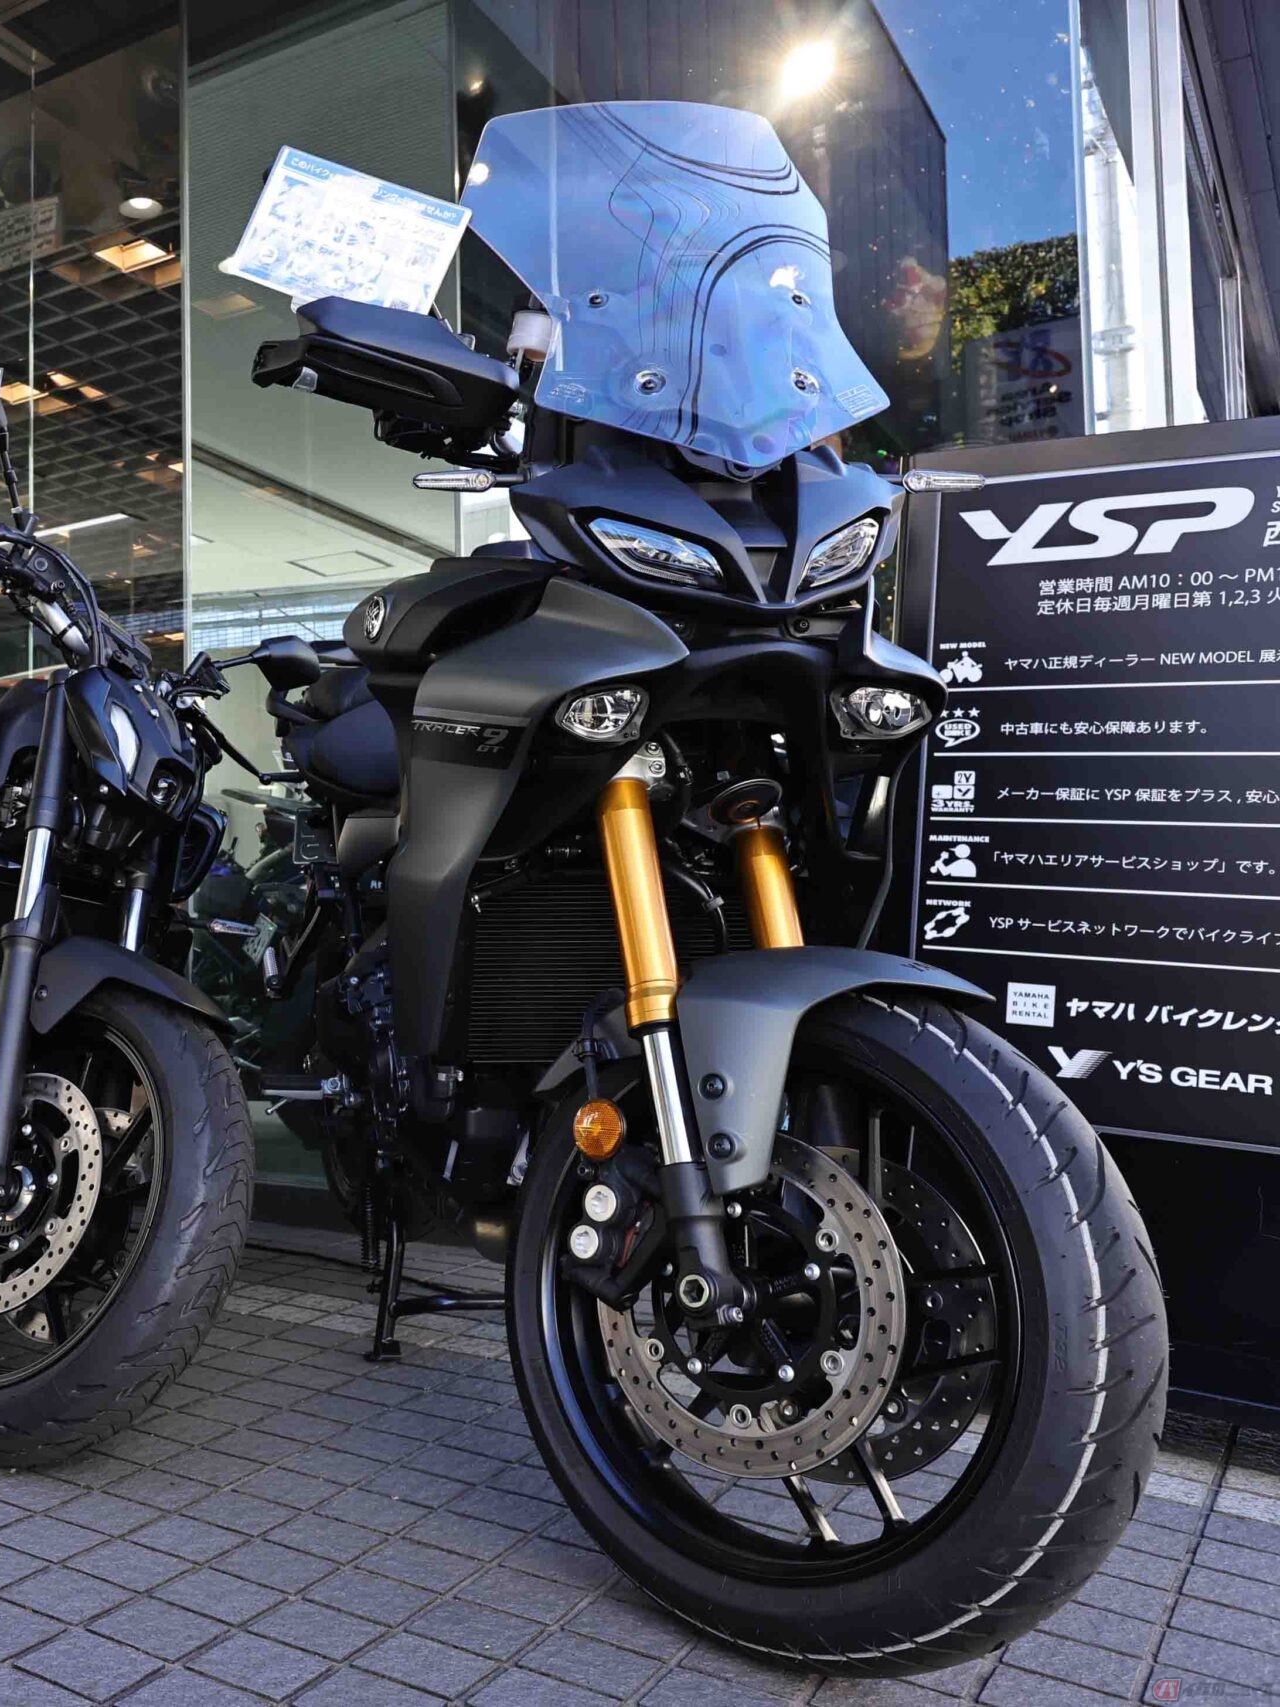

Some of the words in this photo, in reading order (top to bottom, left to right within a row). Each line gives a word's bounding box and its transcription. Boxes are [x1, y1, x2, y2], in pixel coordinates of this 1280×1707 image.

[959, 487, 1254, 566] YSP
[1039, 576, 1113, 596] 営業時間
[1037, 592, 1212, 616] 定休日毎週月曜日第
[1220, 589, 1261, 608] 1,2,3
[959, 641, 987, 649] MODEL
[1005, 654, 1155, 670] ヤマハ正規ディーラー
[1160, 653, 1195, 665] NEW
[1198, 650, 1254, 664] MODEL
[944, 722, 972, 731] USED
[1001, 720, 1206, 736] 中古車にも安心保障あります。
[483, 728, 509, 745] 9
[476, 744, 504, 753] GT
[997, 787, 1099, 801] メーカー保証に
[1105, 788, 1131, 800] YSP
[929, 834, 989, 843] MAINTENANCE
[926, 899, 971, 908] NETWORK
[989, 916, 1013, 929] YSP
[1013, 991, 1050, 1000] YAMAHA
[1012, 1010, 1048, 1019] RENTAL
[1066, 998, 1135, 1021] ヤマハ
[1112, 1059, 1163, 1083] Y'S
[1170, 1066, 1272, 1095] GEAR
